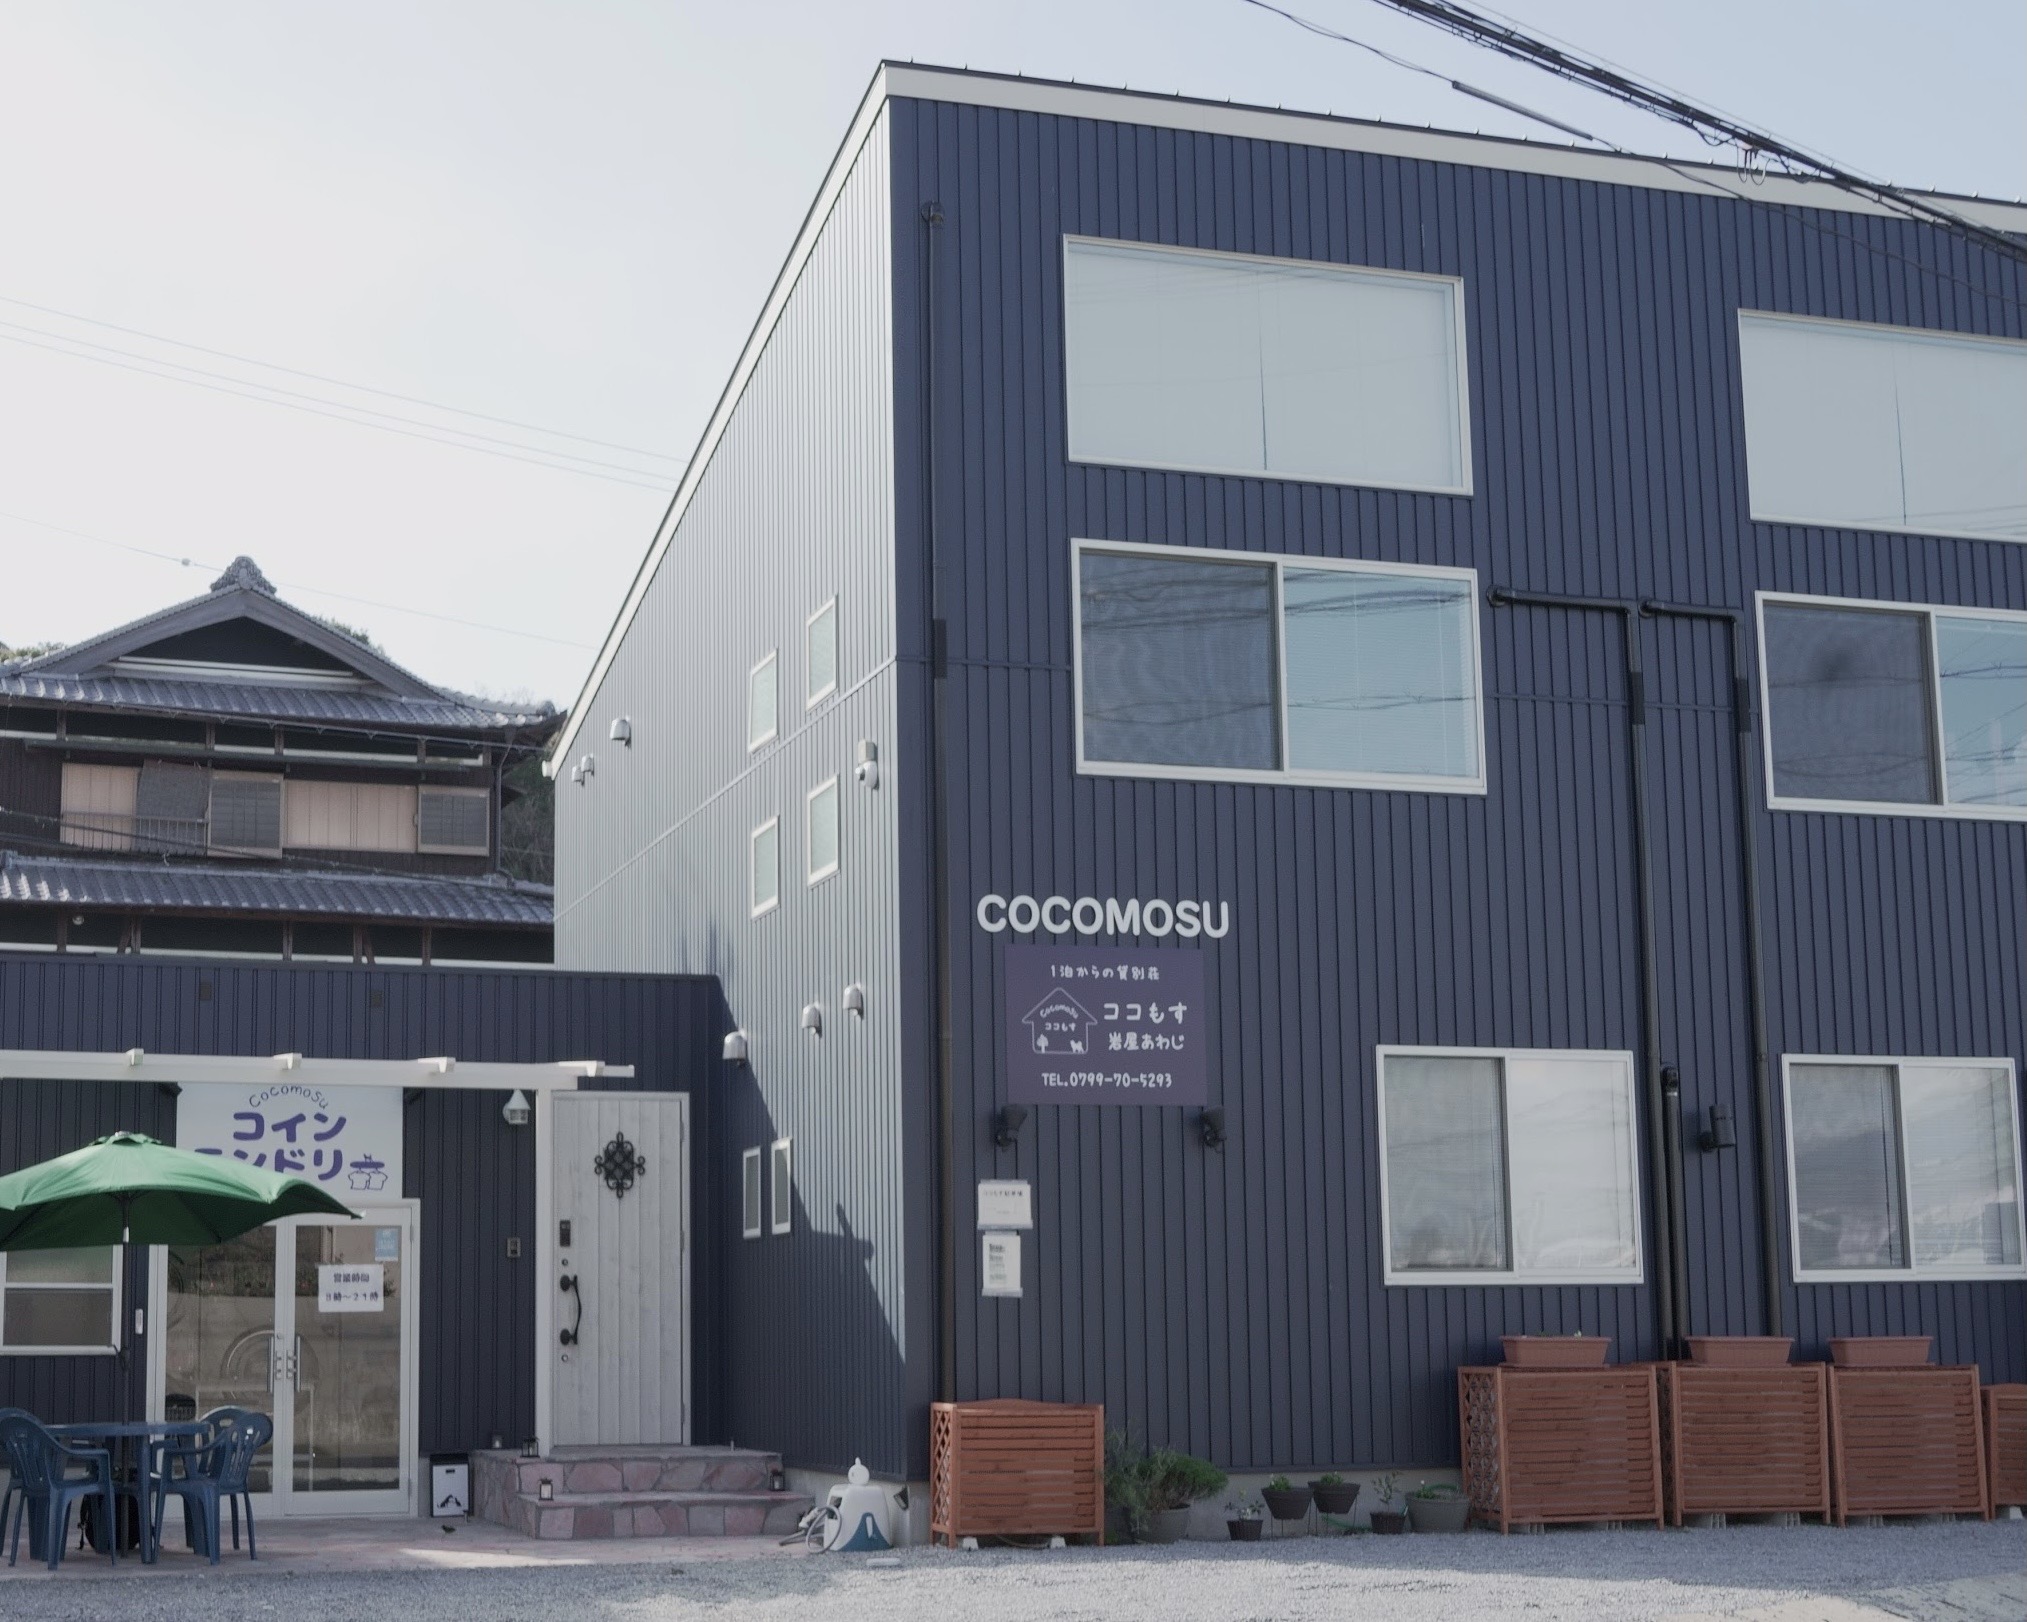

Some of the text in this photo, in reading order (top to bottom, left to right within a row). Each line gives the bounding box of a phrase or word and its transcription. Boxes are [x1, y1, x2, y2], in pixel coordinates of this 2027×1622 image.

[977, 894, 1229, 938] COCOMOSU
[1103, 1001, 1187, 1024] ココもす
[1108, 1031, 1185, 1051] 岩屋あわじ
[1041, 1072, 1172, 1088] TEL.0799-70-5293
[233, 1112, 347, 1143] コイン
